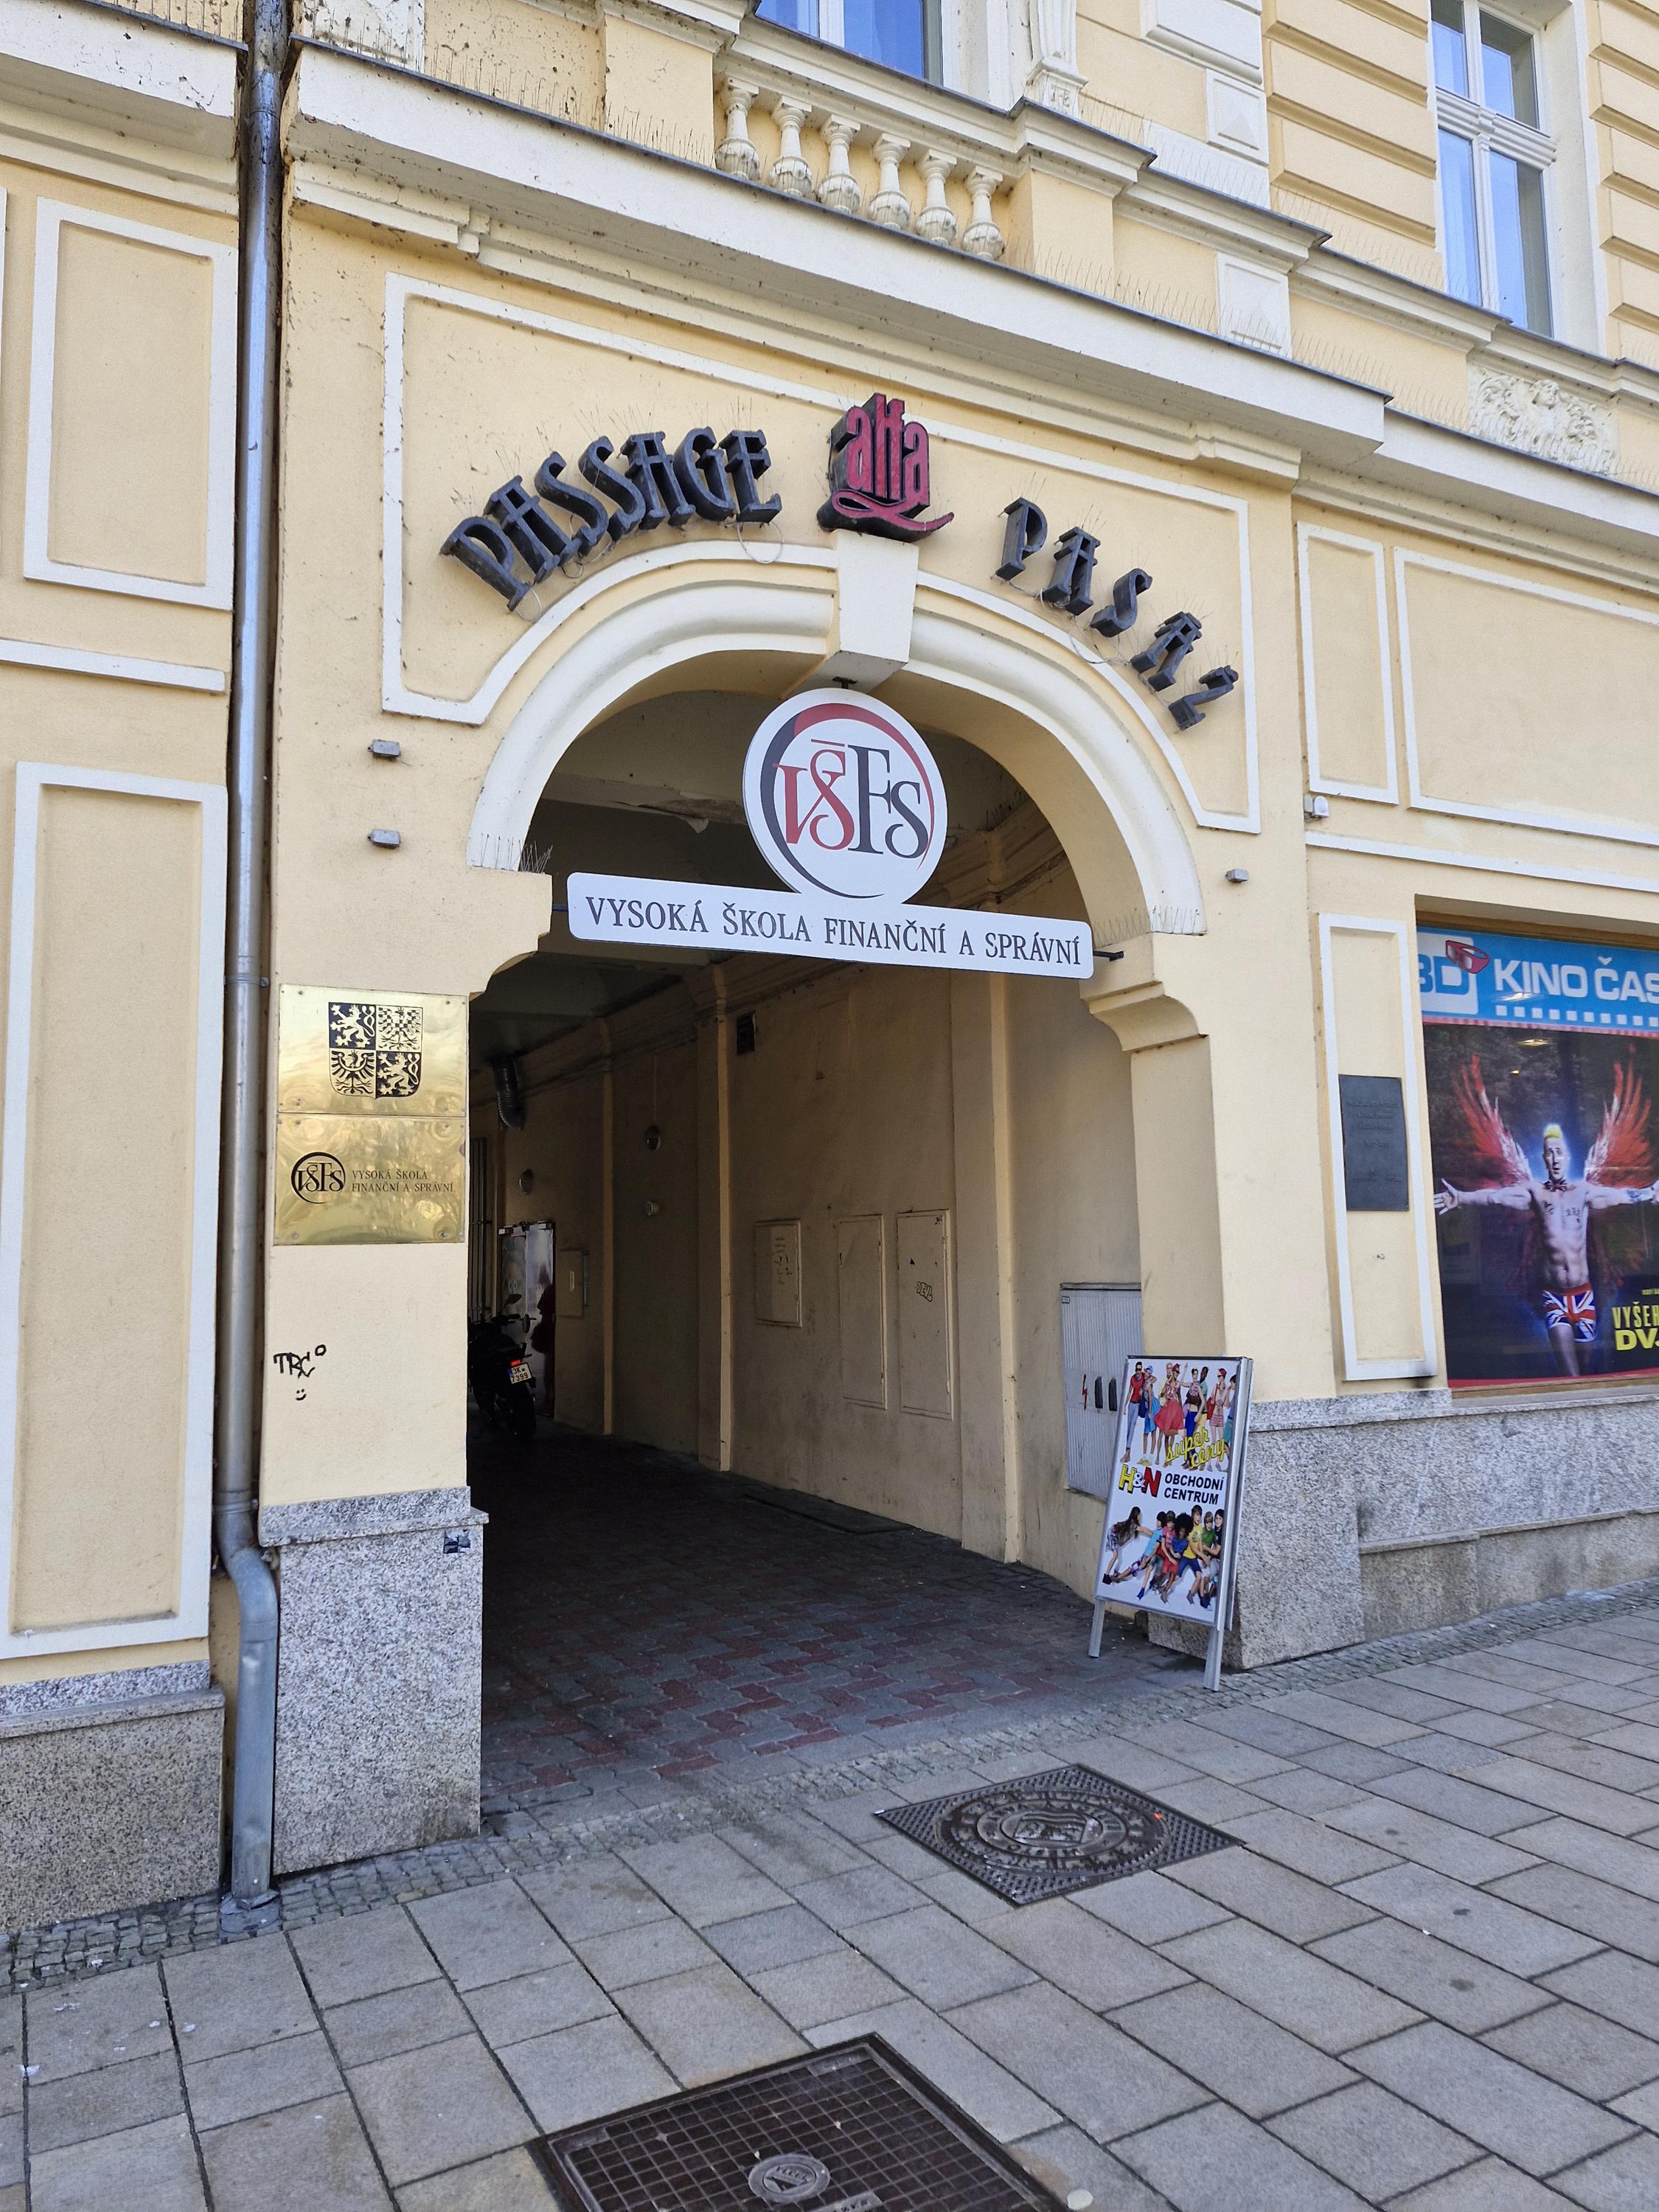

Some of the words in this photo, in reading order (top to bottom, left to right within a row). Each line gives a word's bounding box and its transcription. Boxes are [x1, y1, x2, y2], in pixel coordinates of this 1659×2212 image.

[440, 425, 782, 611] PASSAGE
[585, 895, 709, 933] VYSOKÁ
[722, 901, 812, 943] ŠKOLA
[823, 917, 947, 955] FINANČNÍ
[959, 929, 975, 956] A
[984, 931, 1082, 966] SPRÁVNÍ
[1493, 958, 1589, 998] KINO
[351, 1181, 400, 1192] FINANČNÍ
[403, 1183, 410, 1192] A
[414, 1181, 454, 1192] SPRÁVNÍ
[352, 1168, 392, 1180] VYSOKÁ
[396, 1169, 428, 1180] ŠKOLA
[1615, 1328, 1659, 1351] DV
[511, 1372, 529, 1383] 7399
[1166, 1427, 1209, 1463] super
[1190, 1438, 1226, 1469] ceny
[1118, 1463, 1162, 1498] H&N
[1164, 1472, 1225, 1491] OBCHODNÍ
[1164, 1487, 1219, 1506] CENTRUM
